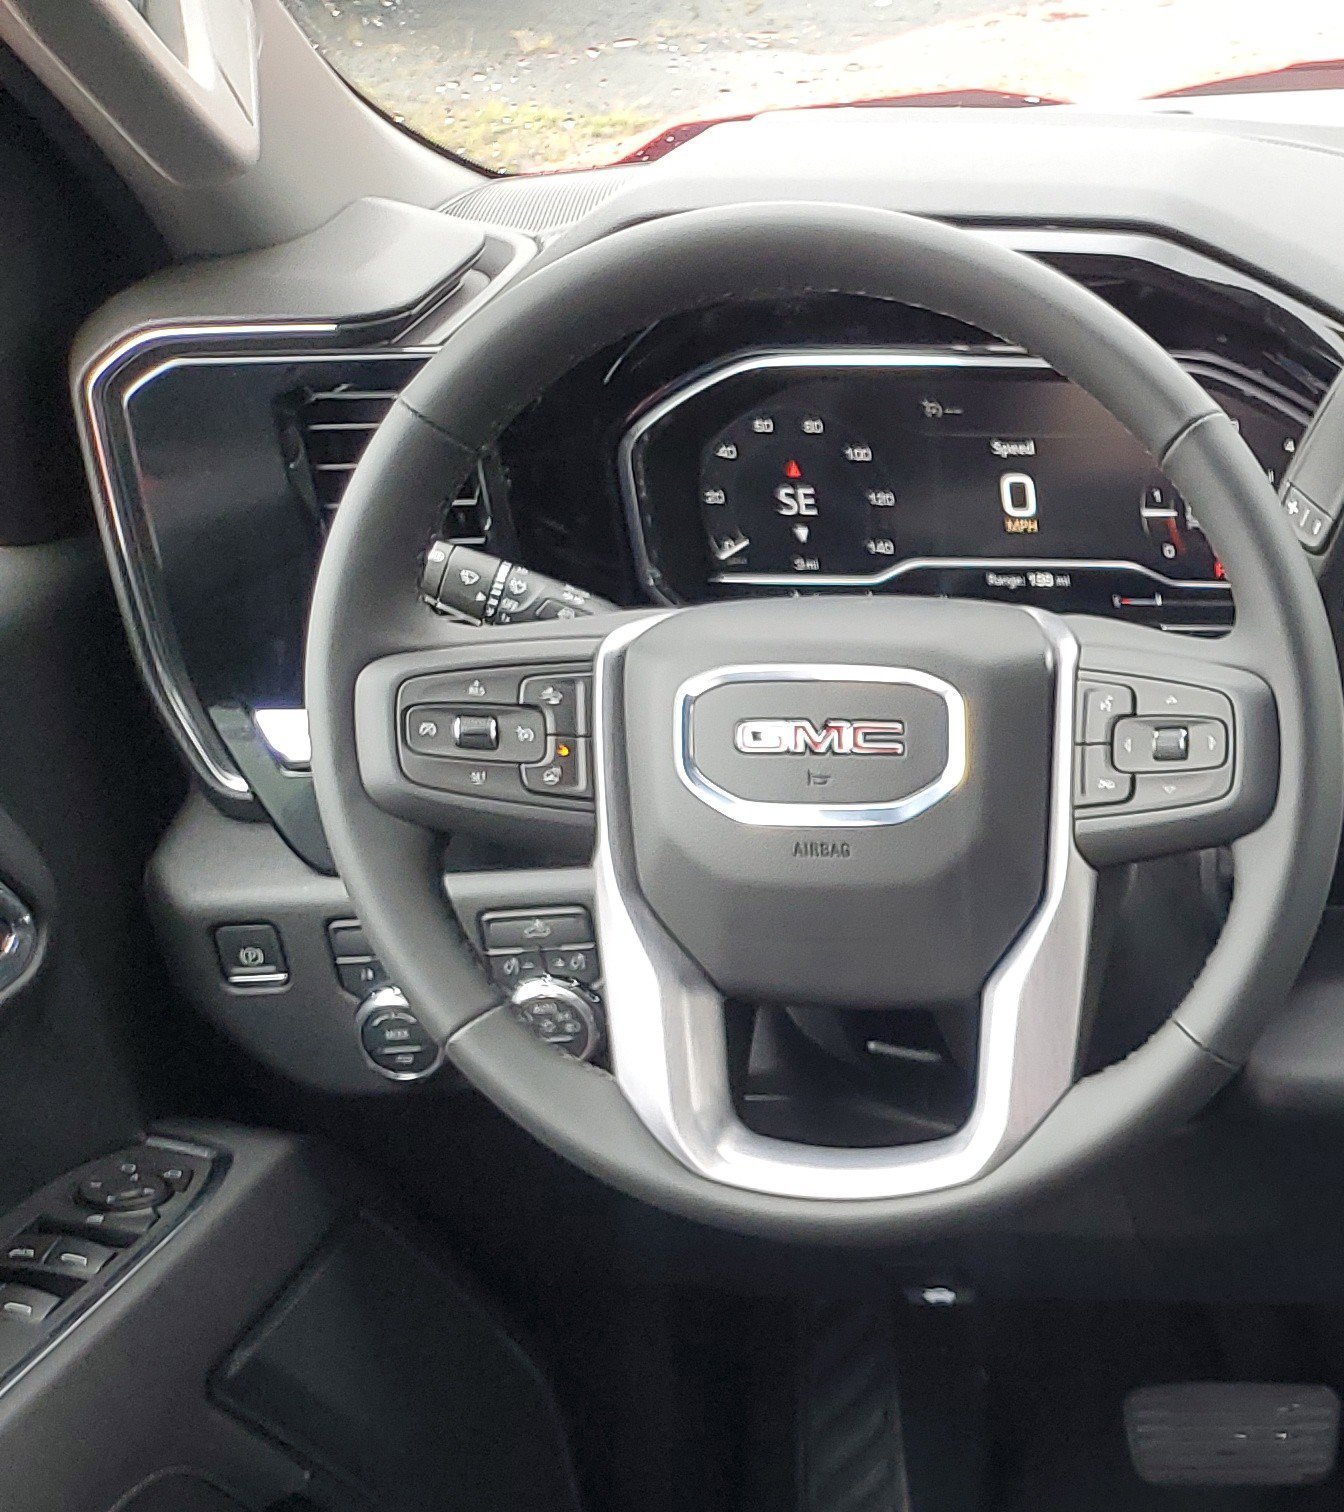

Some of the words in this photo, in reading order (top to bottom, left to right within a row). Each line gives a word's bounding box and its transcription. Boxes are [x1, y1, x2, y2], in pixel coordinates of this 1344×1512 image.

[990, 437, 1036, 459] Speed
[777, 483, 819, 516] SE
[1000, 471, 1037, 518] 0
[1004, 518, 1039, 533] MPH
[734, 717, 906, 756] GMC
[792, 841, 851, 858] AIRBAG
